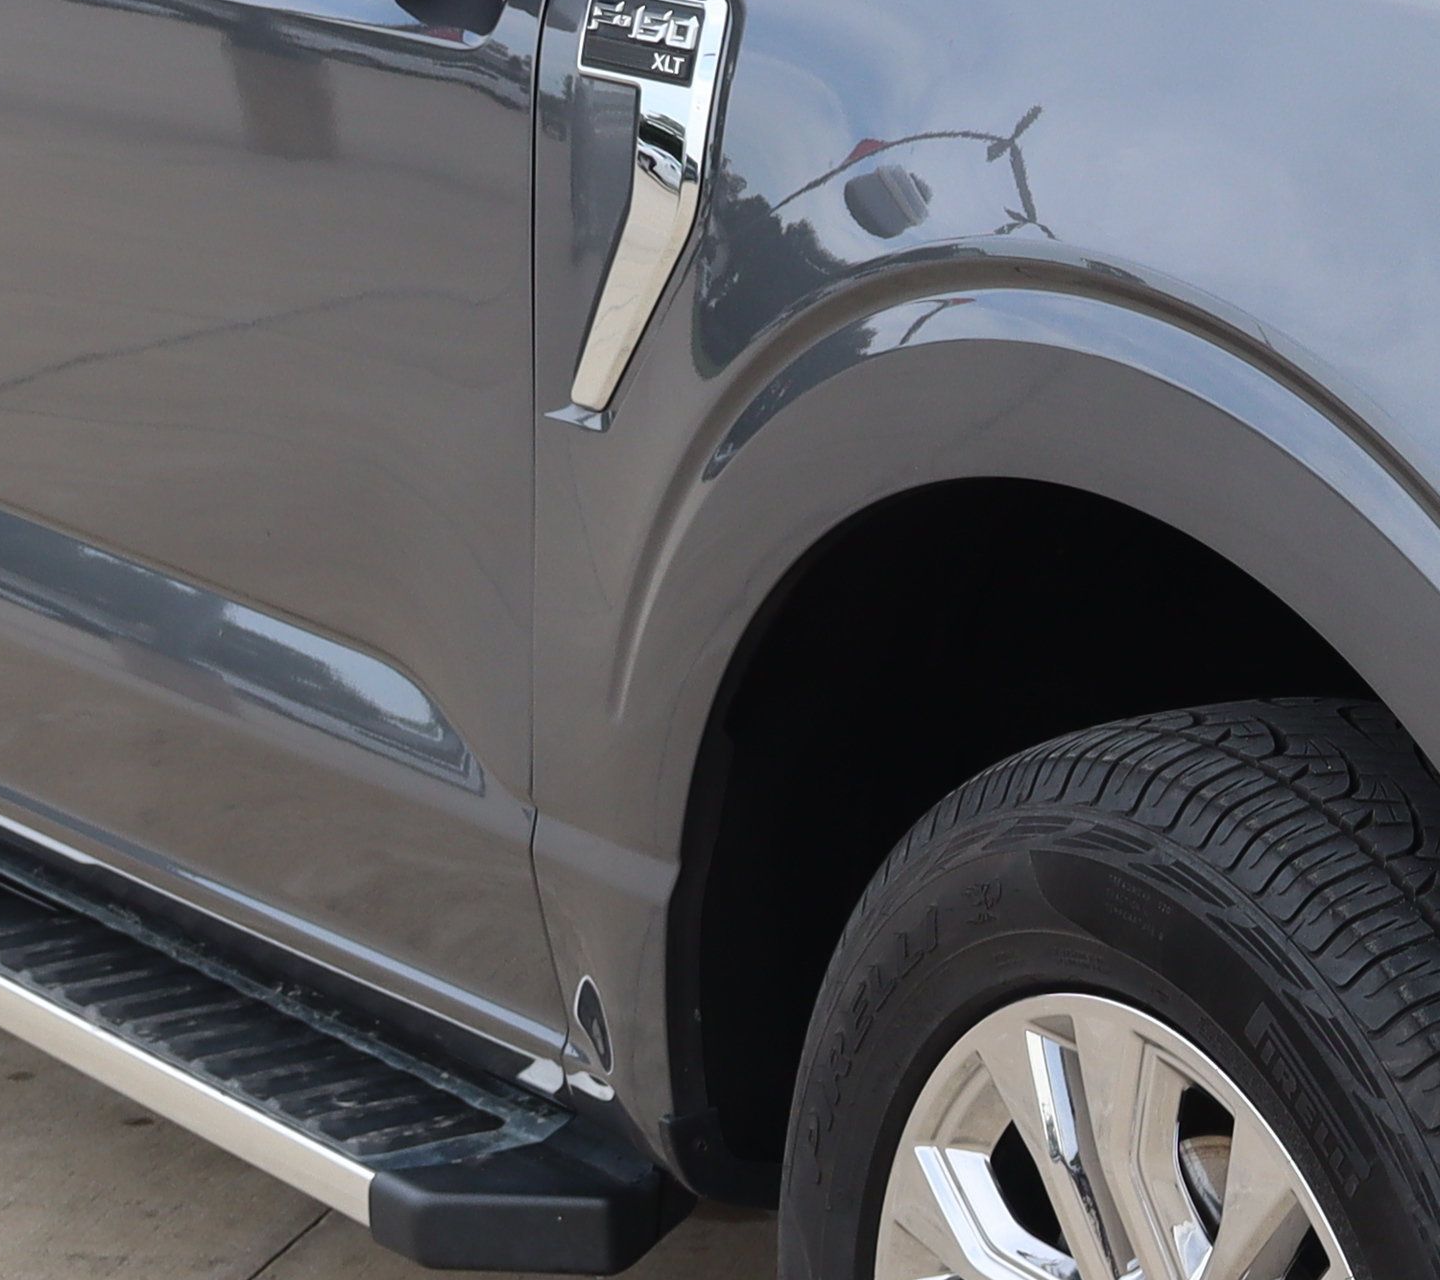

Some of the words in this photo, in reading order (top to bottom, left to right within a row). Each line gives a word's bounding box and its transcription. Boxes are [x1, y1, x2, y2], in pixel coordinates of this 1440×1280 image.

[587, 0, 700, 50] F-150
[651, 52, 685, 75] XLT
[1243, 1001, 1372, 1199] PIRELLI
